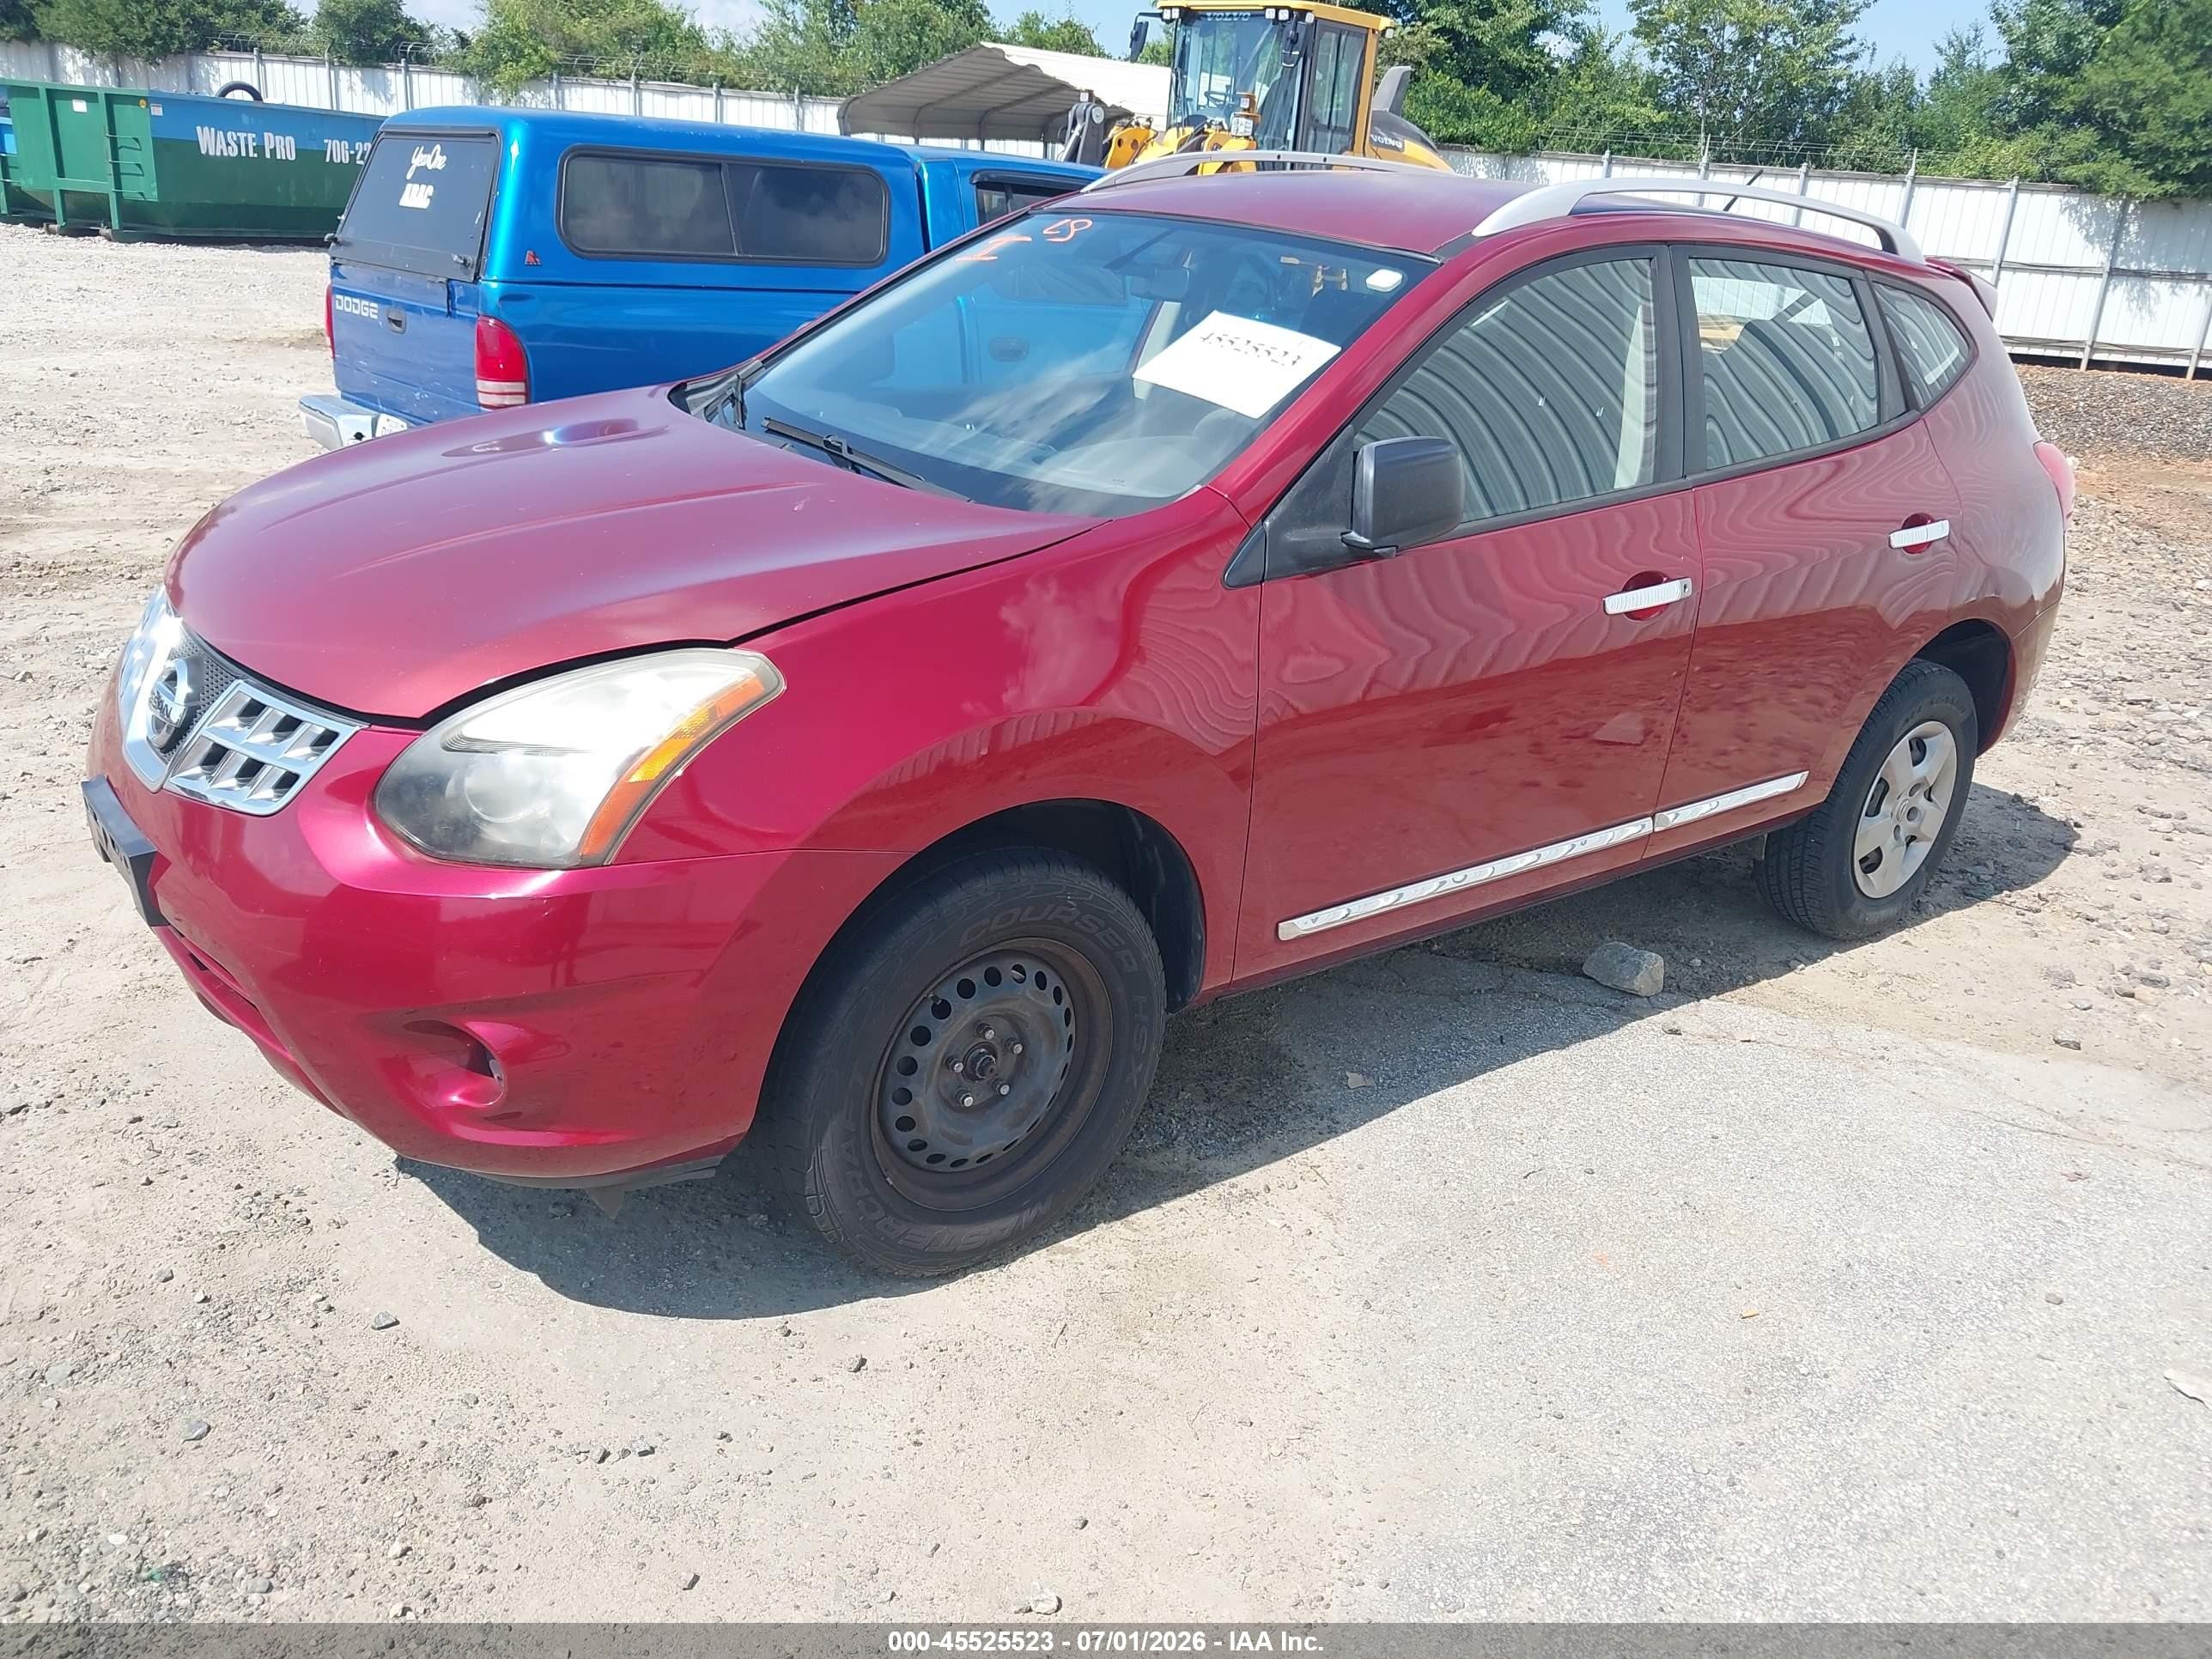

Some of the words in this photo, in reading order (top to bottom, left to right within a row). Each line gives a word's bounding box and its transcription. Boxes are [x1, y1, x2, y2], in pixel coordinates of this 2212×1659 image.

[1206, 12, 1251, 21] VOLVO
[1370, 134, 1403, 149] VOLVO
[335, 294, 379, 319] DODGE
[960, 905, 1138, 974] COURSER
